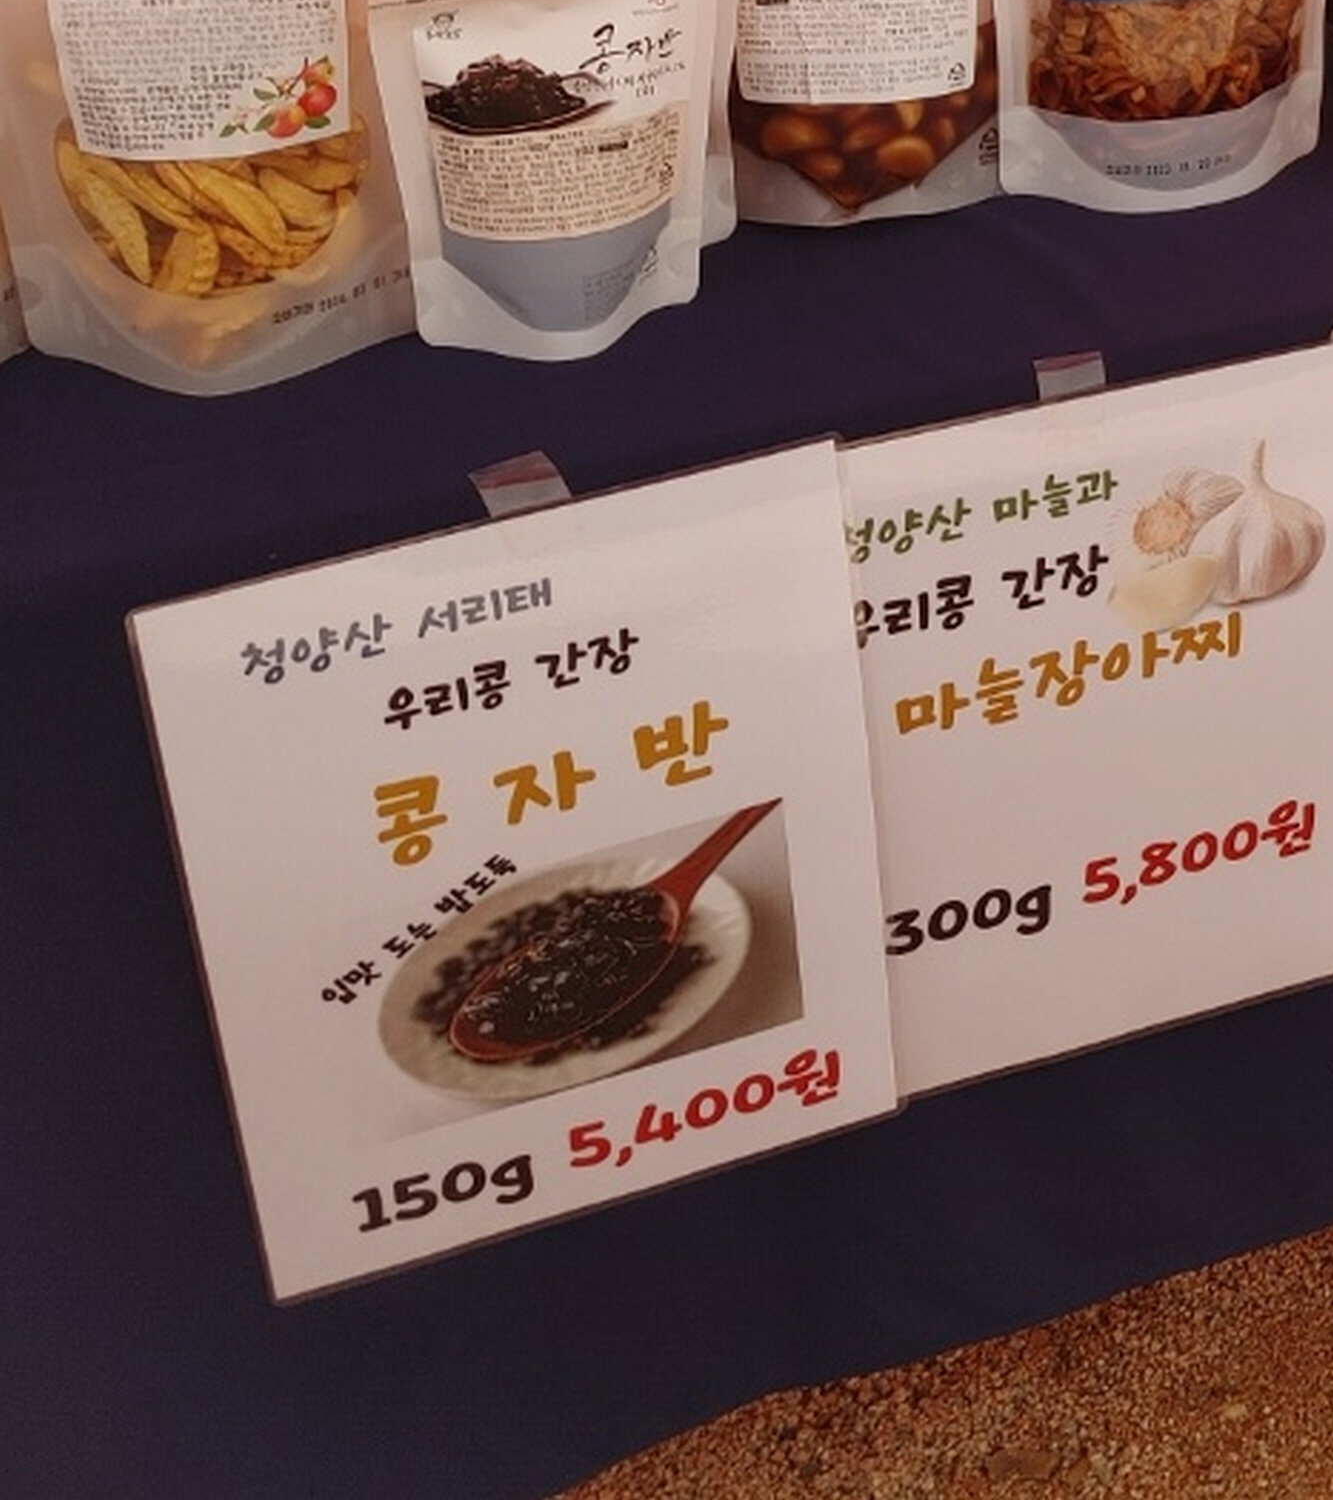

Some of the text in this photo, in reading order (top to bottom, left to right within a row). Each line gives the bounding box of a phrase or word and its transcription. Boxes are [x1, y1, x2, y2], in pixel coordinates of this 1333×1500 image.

[578, 23, 682, 75] 콩자반
[993, 470, 1118, 525] 마늘과
[241, 577, 555, 686] 청양산 서리태
[1002, 545, 1109, 610] 간장
[384, 629, 640, 730] 우리콩 간장
[896, 612, 1242, 734] 마늘장아찌
[373, 700, 731, 868] 콩 자 반
[321, 854, 520, 1009] 입맛 도는 밥도둑
[885, 800, 1317, 957] 300g 5,800원
[352, 1049, 843, 1233] 150g 5,400원
